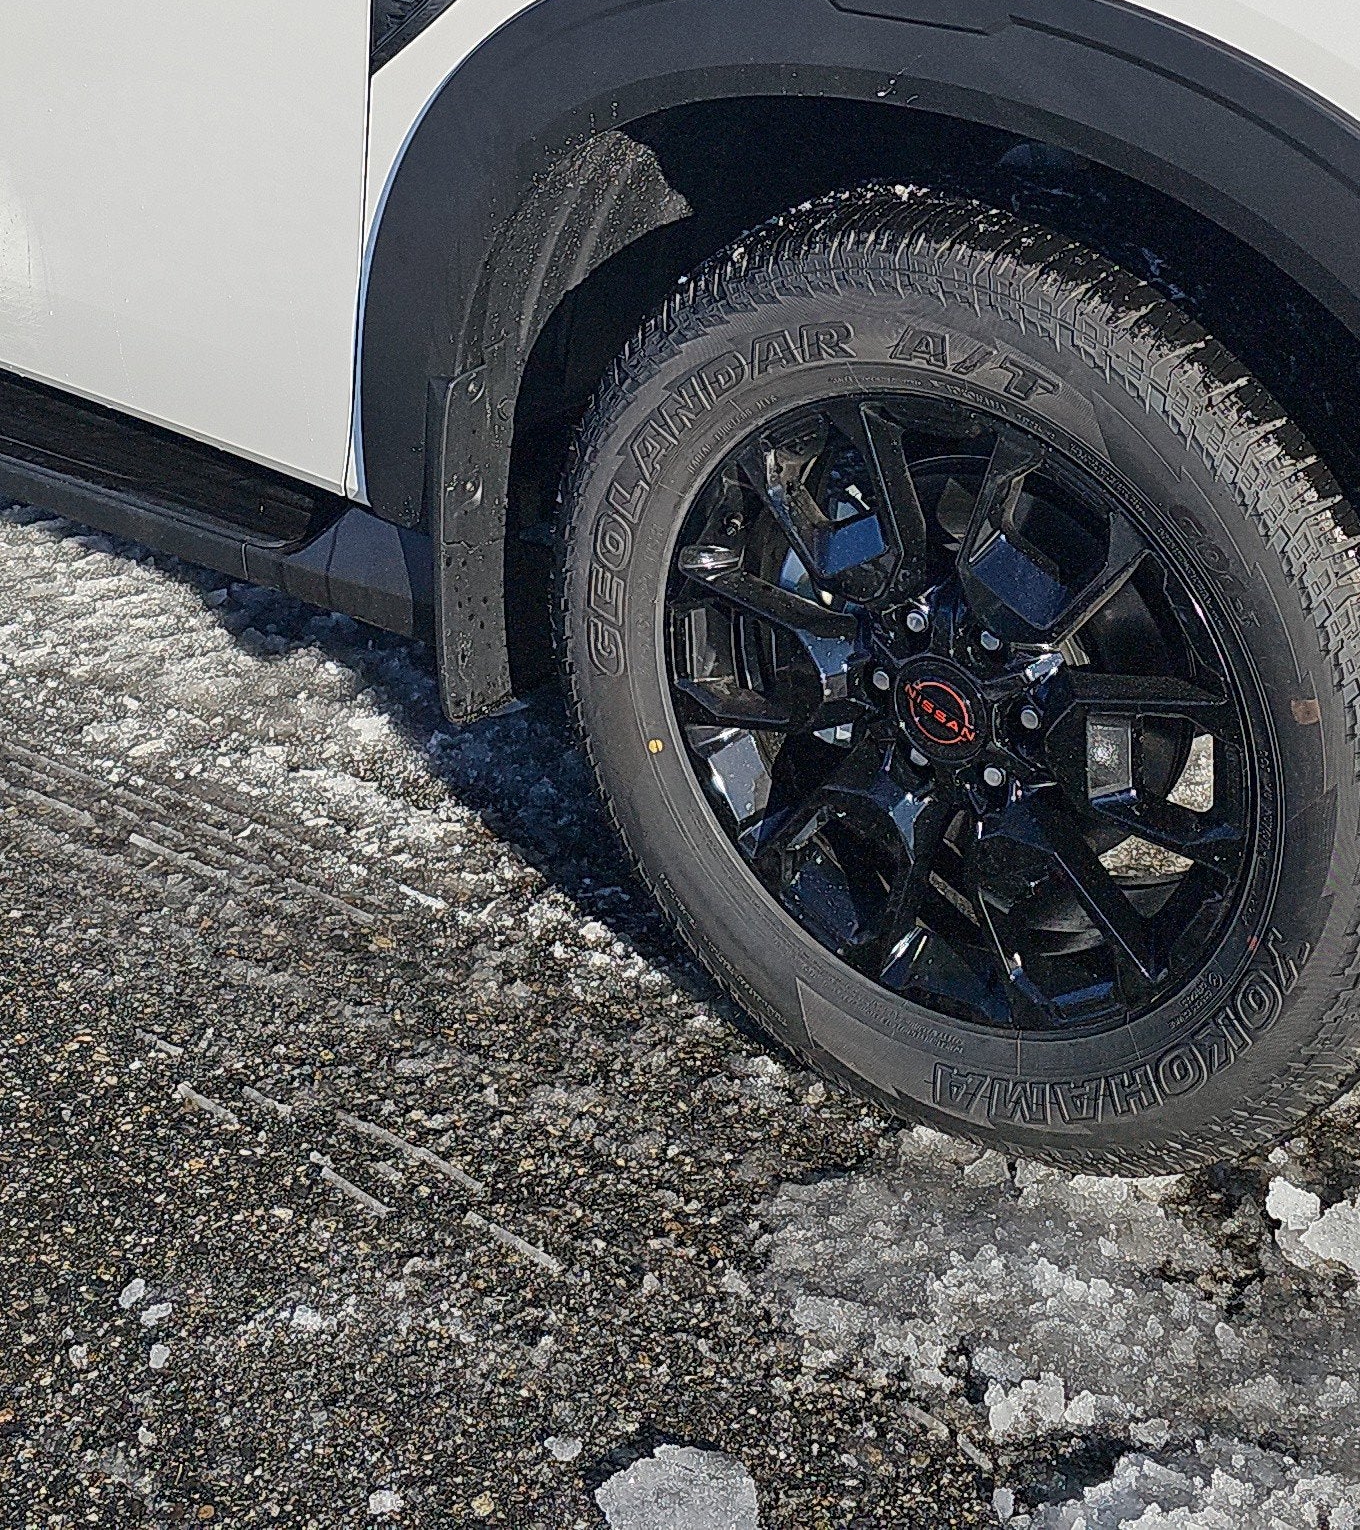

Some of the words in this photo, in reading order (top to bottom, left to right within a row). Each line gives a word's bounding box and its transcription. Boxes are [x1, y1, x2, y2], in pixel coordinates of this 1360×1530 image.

[586, 321, 856, 675] GEOLANDAR
[889, 326, 1062, 401] A/T
[904, 683, 975, 742] NISSAN
[933, 927, 1312, 1127] YOKOHAMA
